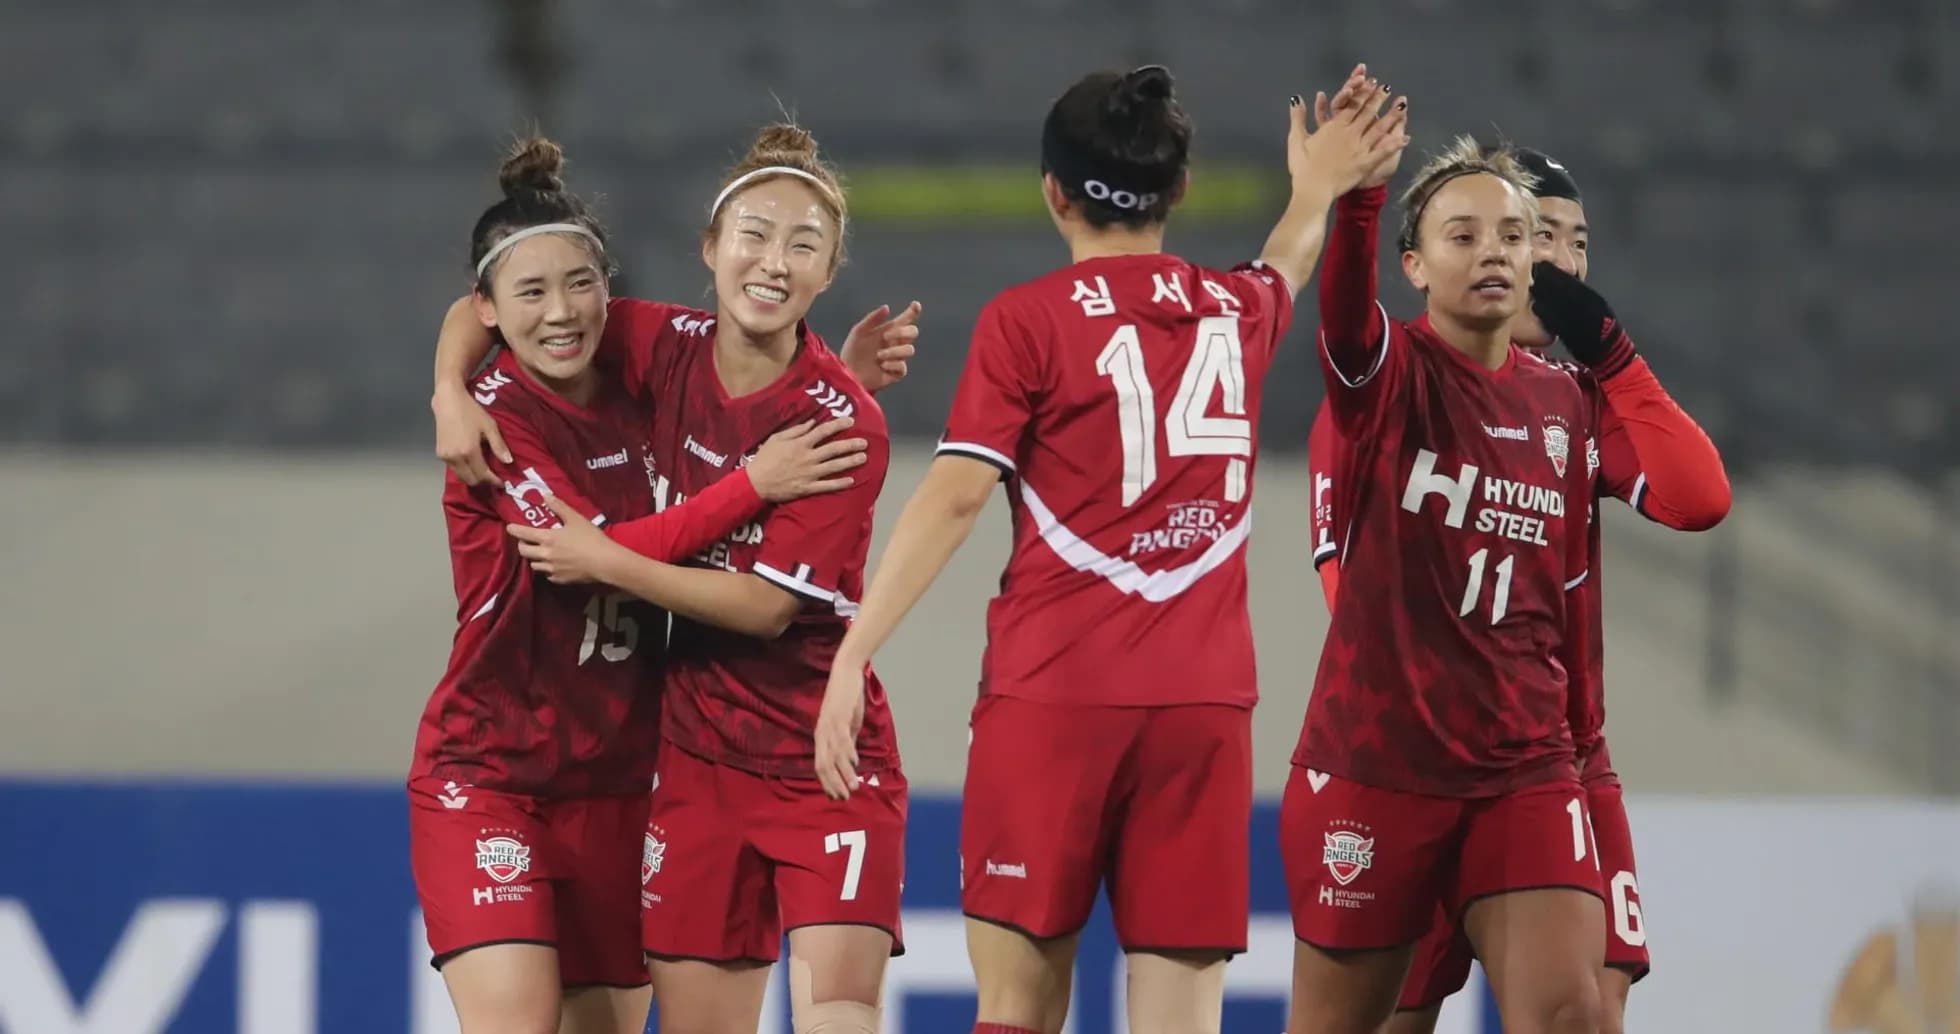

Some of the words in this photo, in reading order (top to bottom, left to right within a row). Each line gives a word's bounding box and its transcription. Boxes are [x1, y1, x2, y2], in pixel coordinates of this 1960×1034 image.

[1096, 316, 1251, 507] 14
[586, 447, 628, 470] ummel
[683, 434, 728, 468] hummel
[1484, 475, 1565, 518] HYUND
[1167, 507, 1217, 528] RED
[1474, 507, 1549, 547] STEEL
[1459, 547, 1514, 627] 11
[577, 591, 639, 667] 15
[1337, 840, 1356, 850] RED
[1566, 798, 1600, 872] 1
[494, 845, 514, 855] RED
[1325, 848, 1370, 867] ANGELS
[479, 854, 529, 870] ANGELS
[824, 830, 867, 901] 7
[496, 893, 525, 902] STEEL
[1335, 889, 1376, 900] HYUNDAI
[1335, 898, 1361, 908] STEEL
